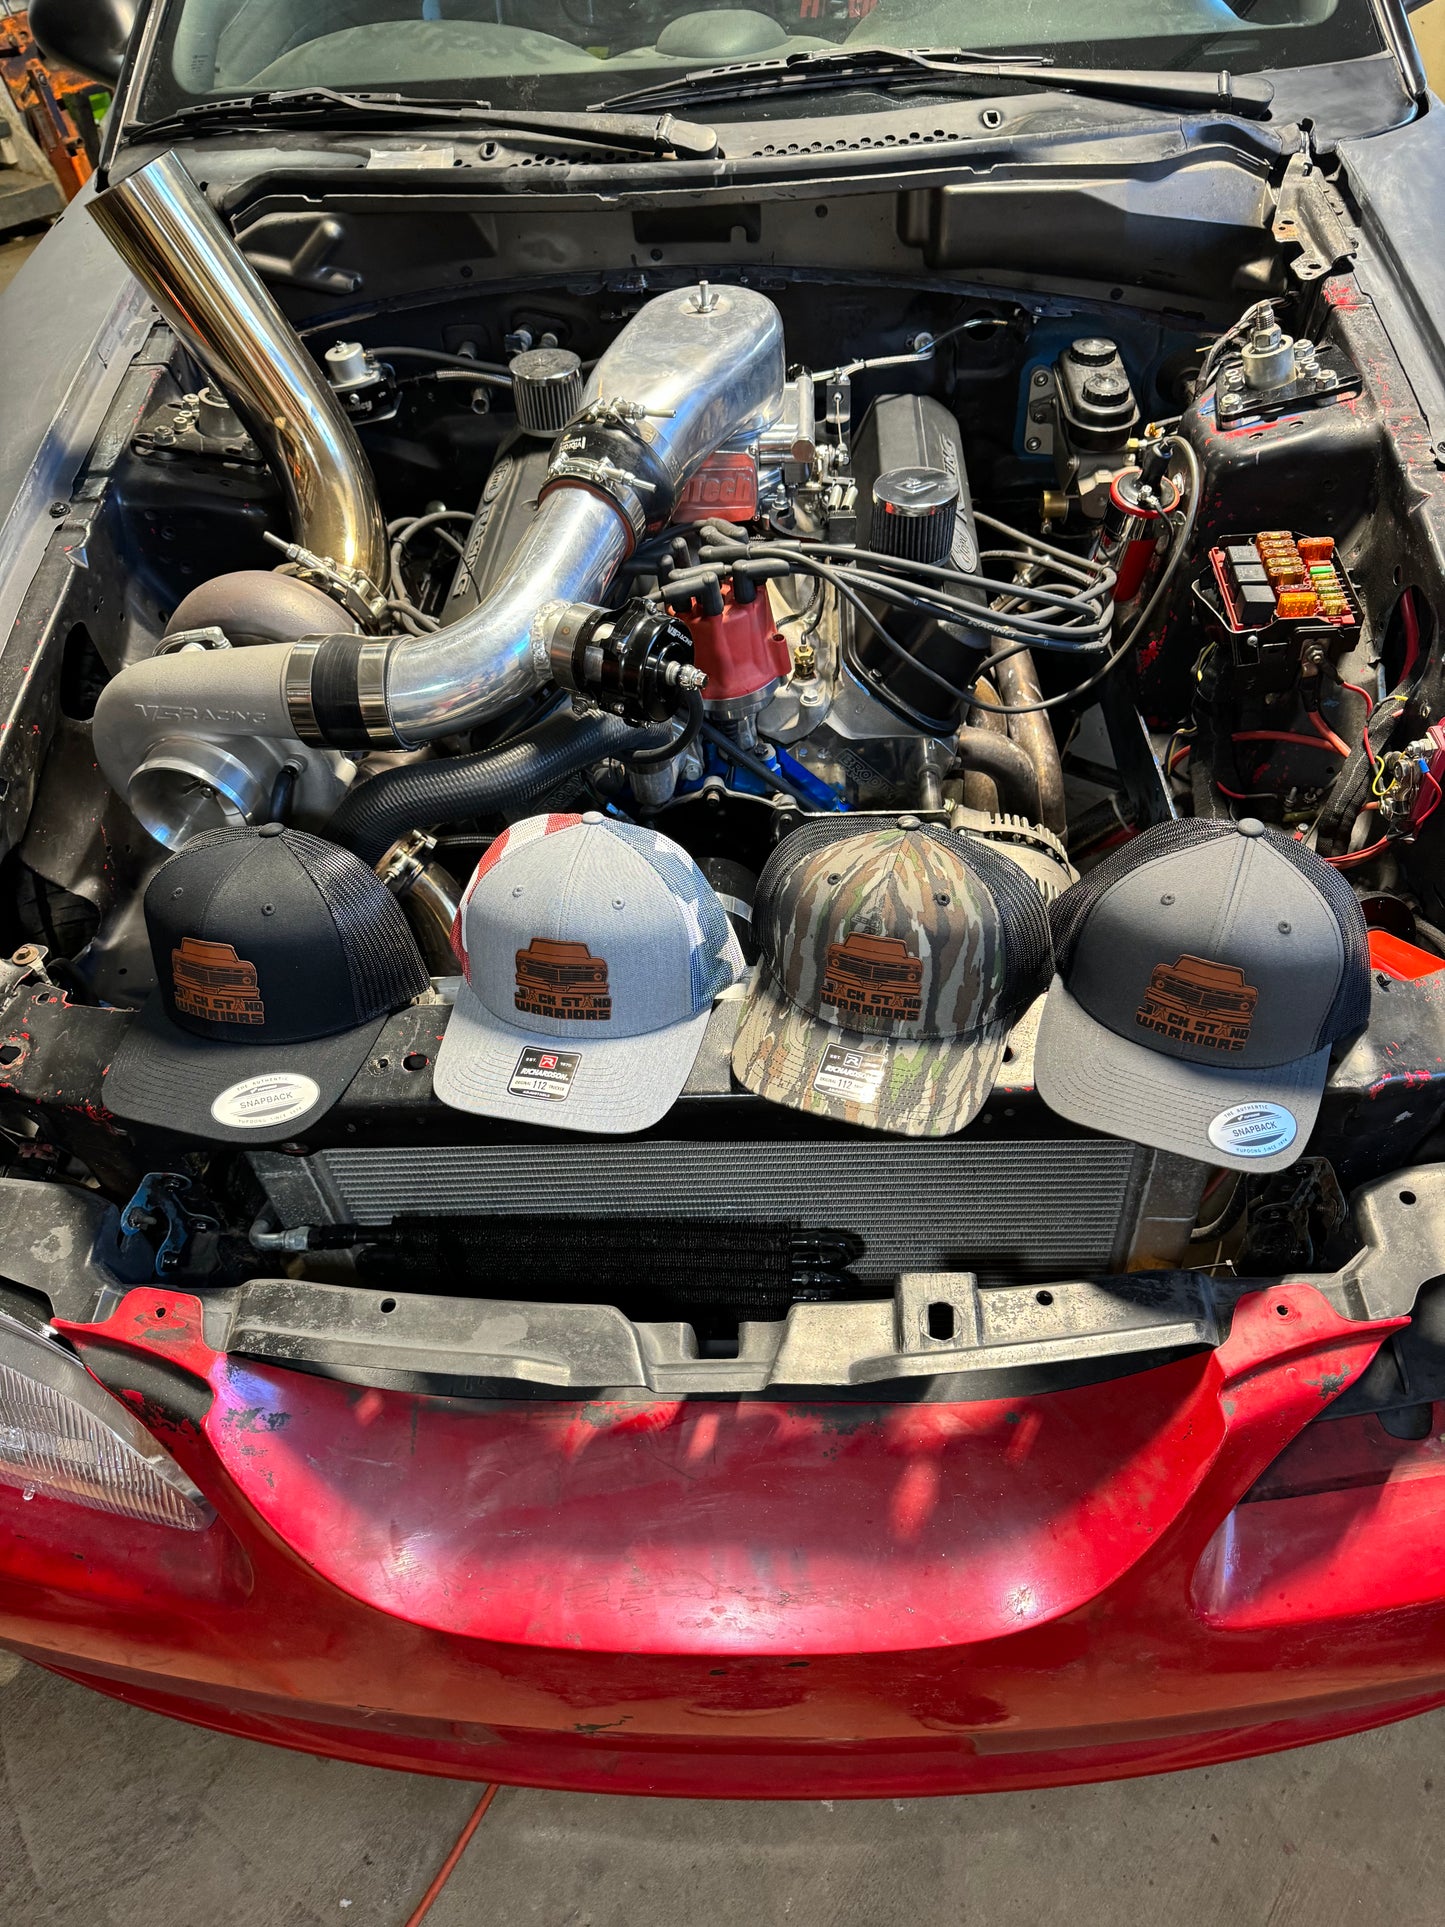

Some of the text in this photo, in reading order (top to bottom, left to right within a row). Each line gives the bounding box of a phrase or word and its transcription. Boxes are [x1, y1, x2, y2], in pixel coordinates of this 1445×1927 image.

[212, 997, 264, 1012] STAND
[561, 994, 611, 1008] STAND
[820, 992, 921, 1021] WARRIORS
[870, 992, 922, 1009] STAND
[175, 998, 264, 1024] WARRIORS
[514, 1000, 611, 1020] WARRIORS
[1136, 1013, 1247, 1051] WARRIORS
[1193, 1020, 1251, 1040] STAND
[533, 1080, 547, 1091] 112
[838, 1079, 853, 1090] 112
[239, 1091, 293, 1110] SNAPBACK
[1236, 1104, 1268, 1112] AUTHENTIC
[1232, 1121, 1277, 1137] SNAPBACK
